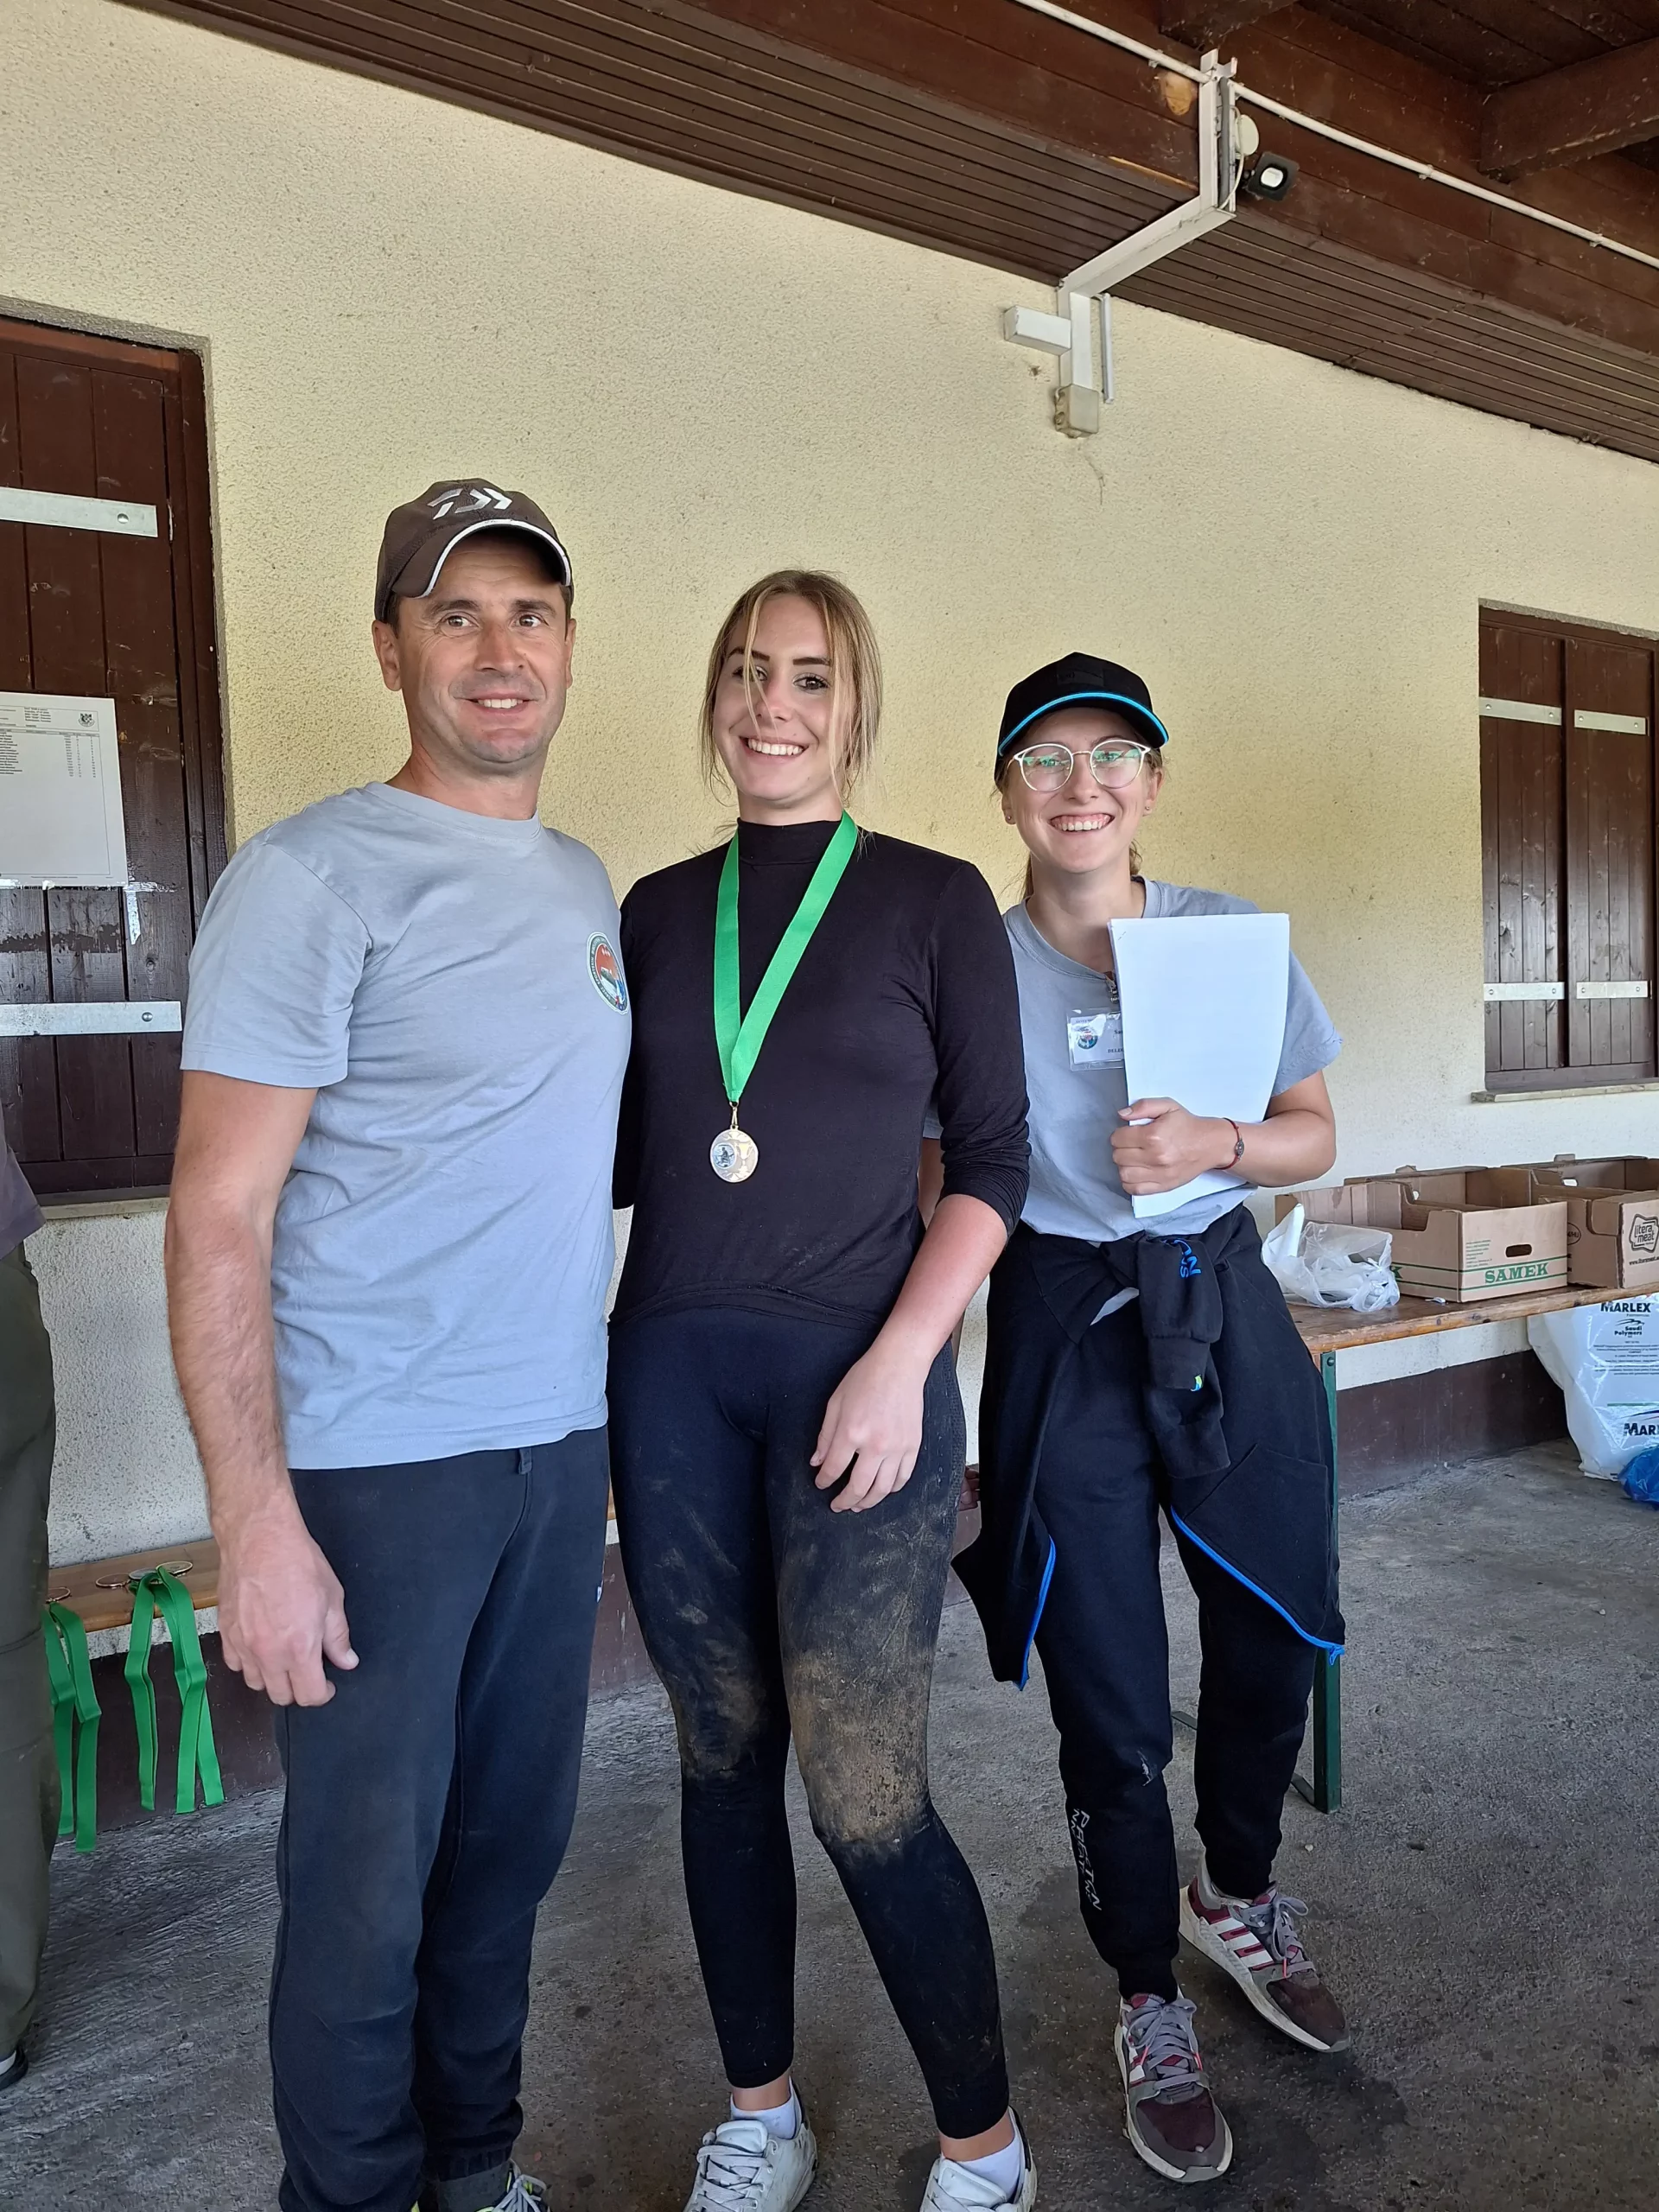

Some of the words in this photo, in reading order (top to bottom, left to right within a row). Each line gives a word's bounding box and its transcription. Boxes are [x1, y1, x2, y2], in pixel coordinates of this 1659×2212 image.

[1637, 1230, 1655, 1243] meat
[1484, 1262, 1549, 1284] SAMEK
[1600, 1301, 1651, 1313] MARLEX
[1624, 1422, 1659, 1436] MAR
